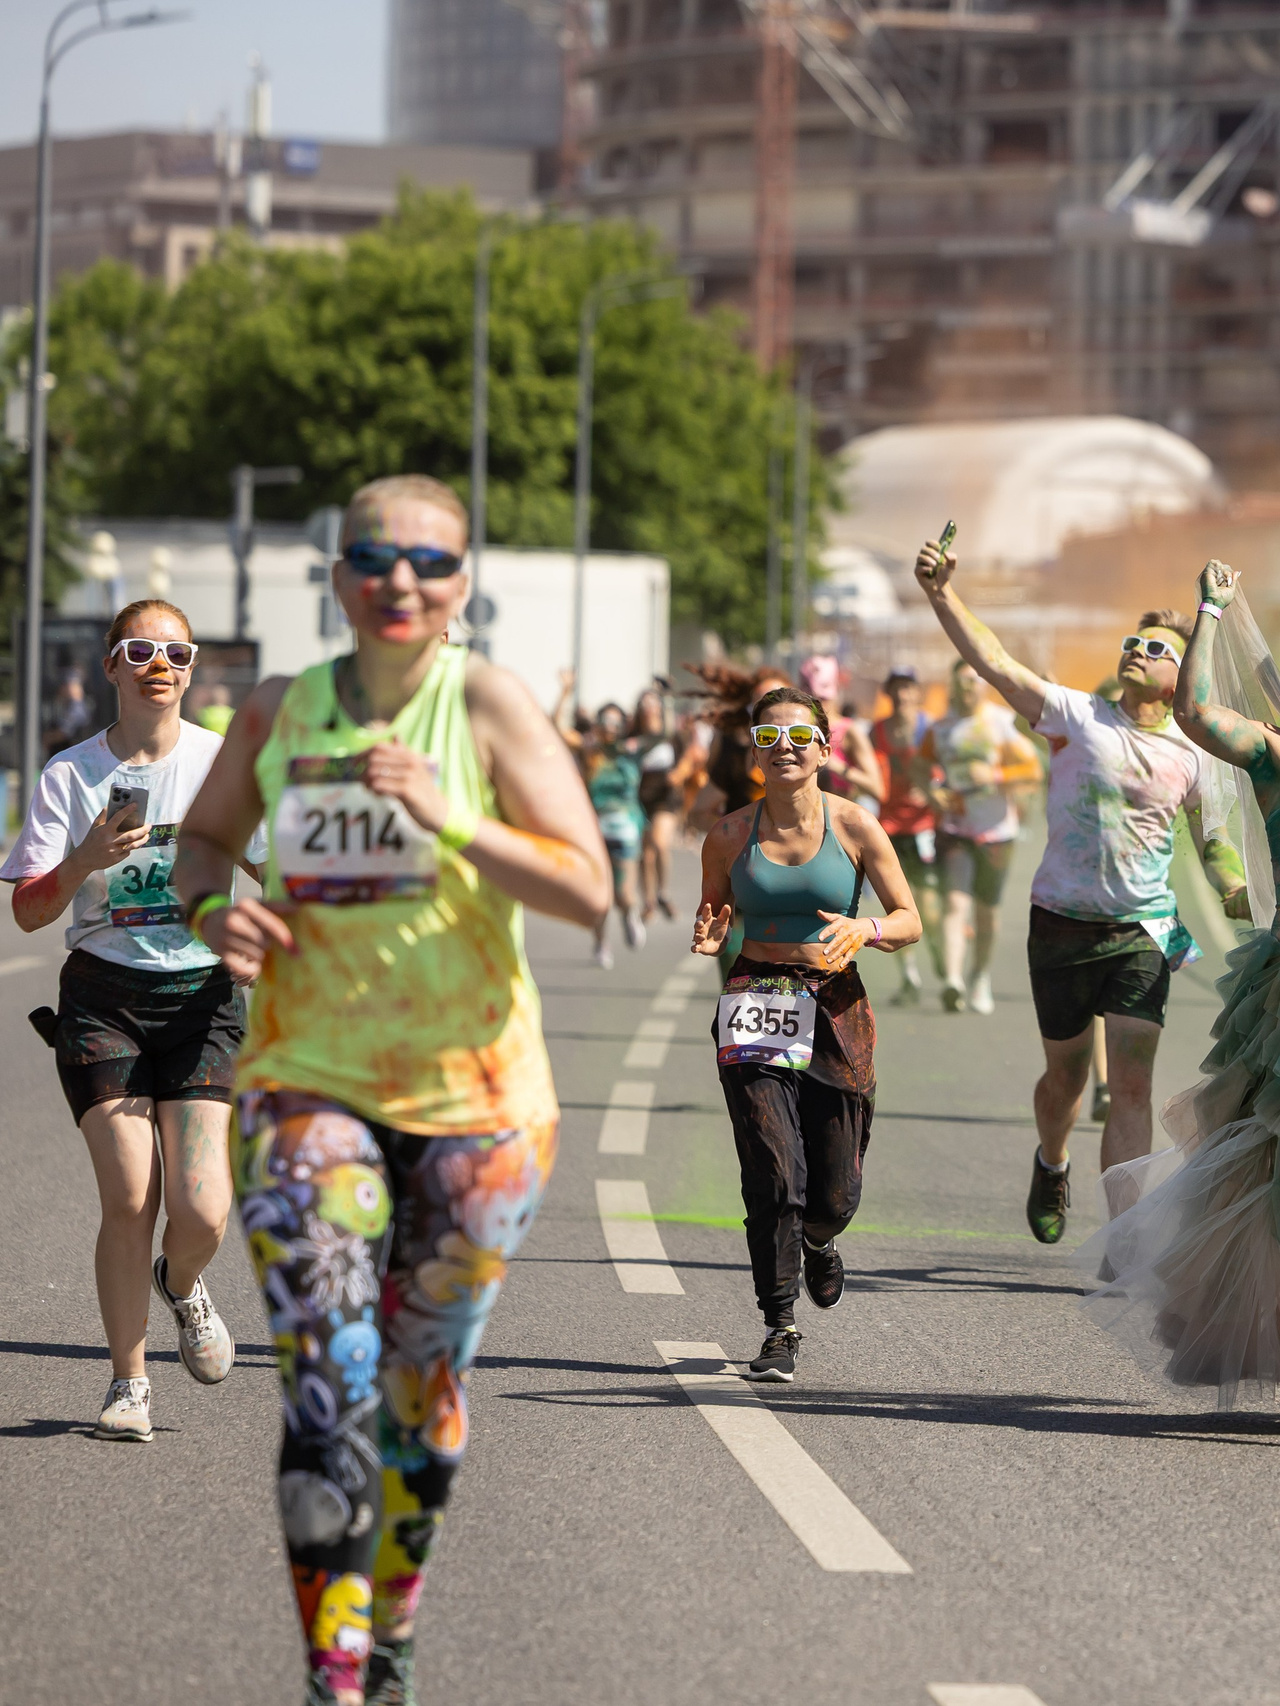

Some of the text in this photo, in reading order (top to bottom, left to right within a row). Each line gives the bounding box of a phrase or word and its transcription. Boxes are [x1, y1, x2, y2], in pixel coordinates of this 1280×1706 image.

[303, 808, 404, 853] 2114
[122, 863, 177, 895] 34
[727, 1005, 800, 1038] 4355
